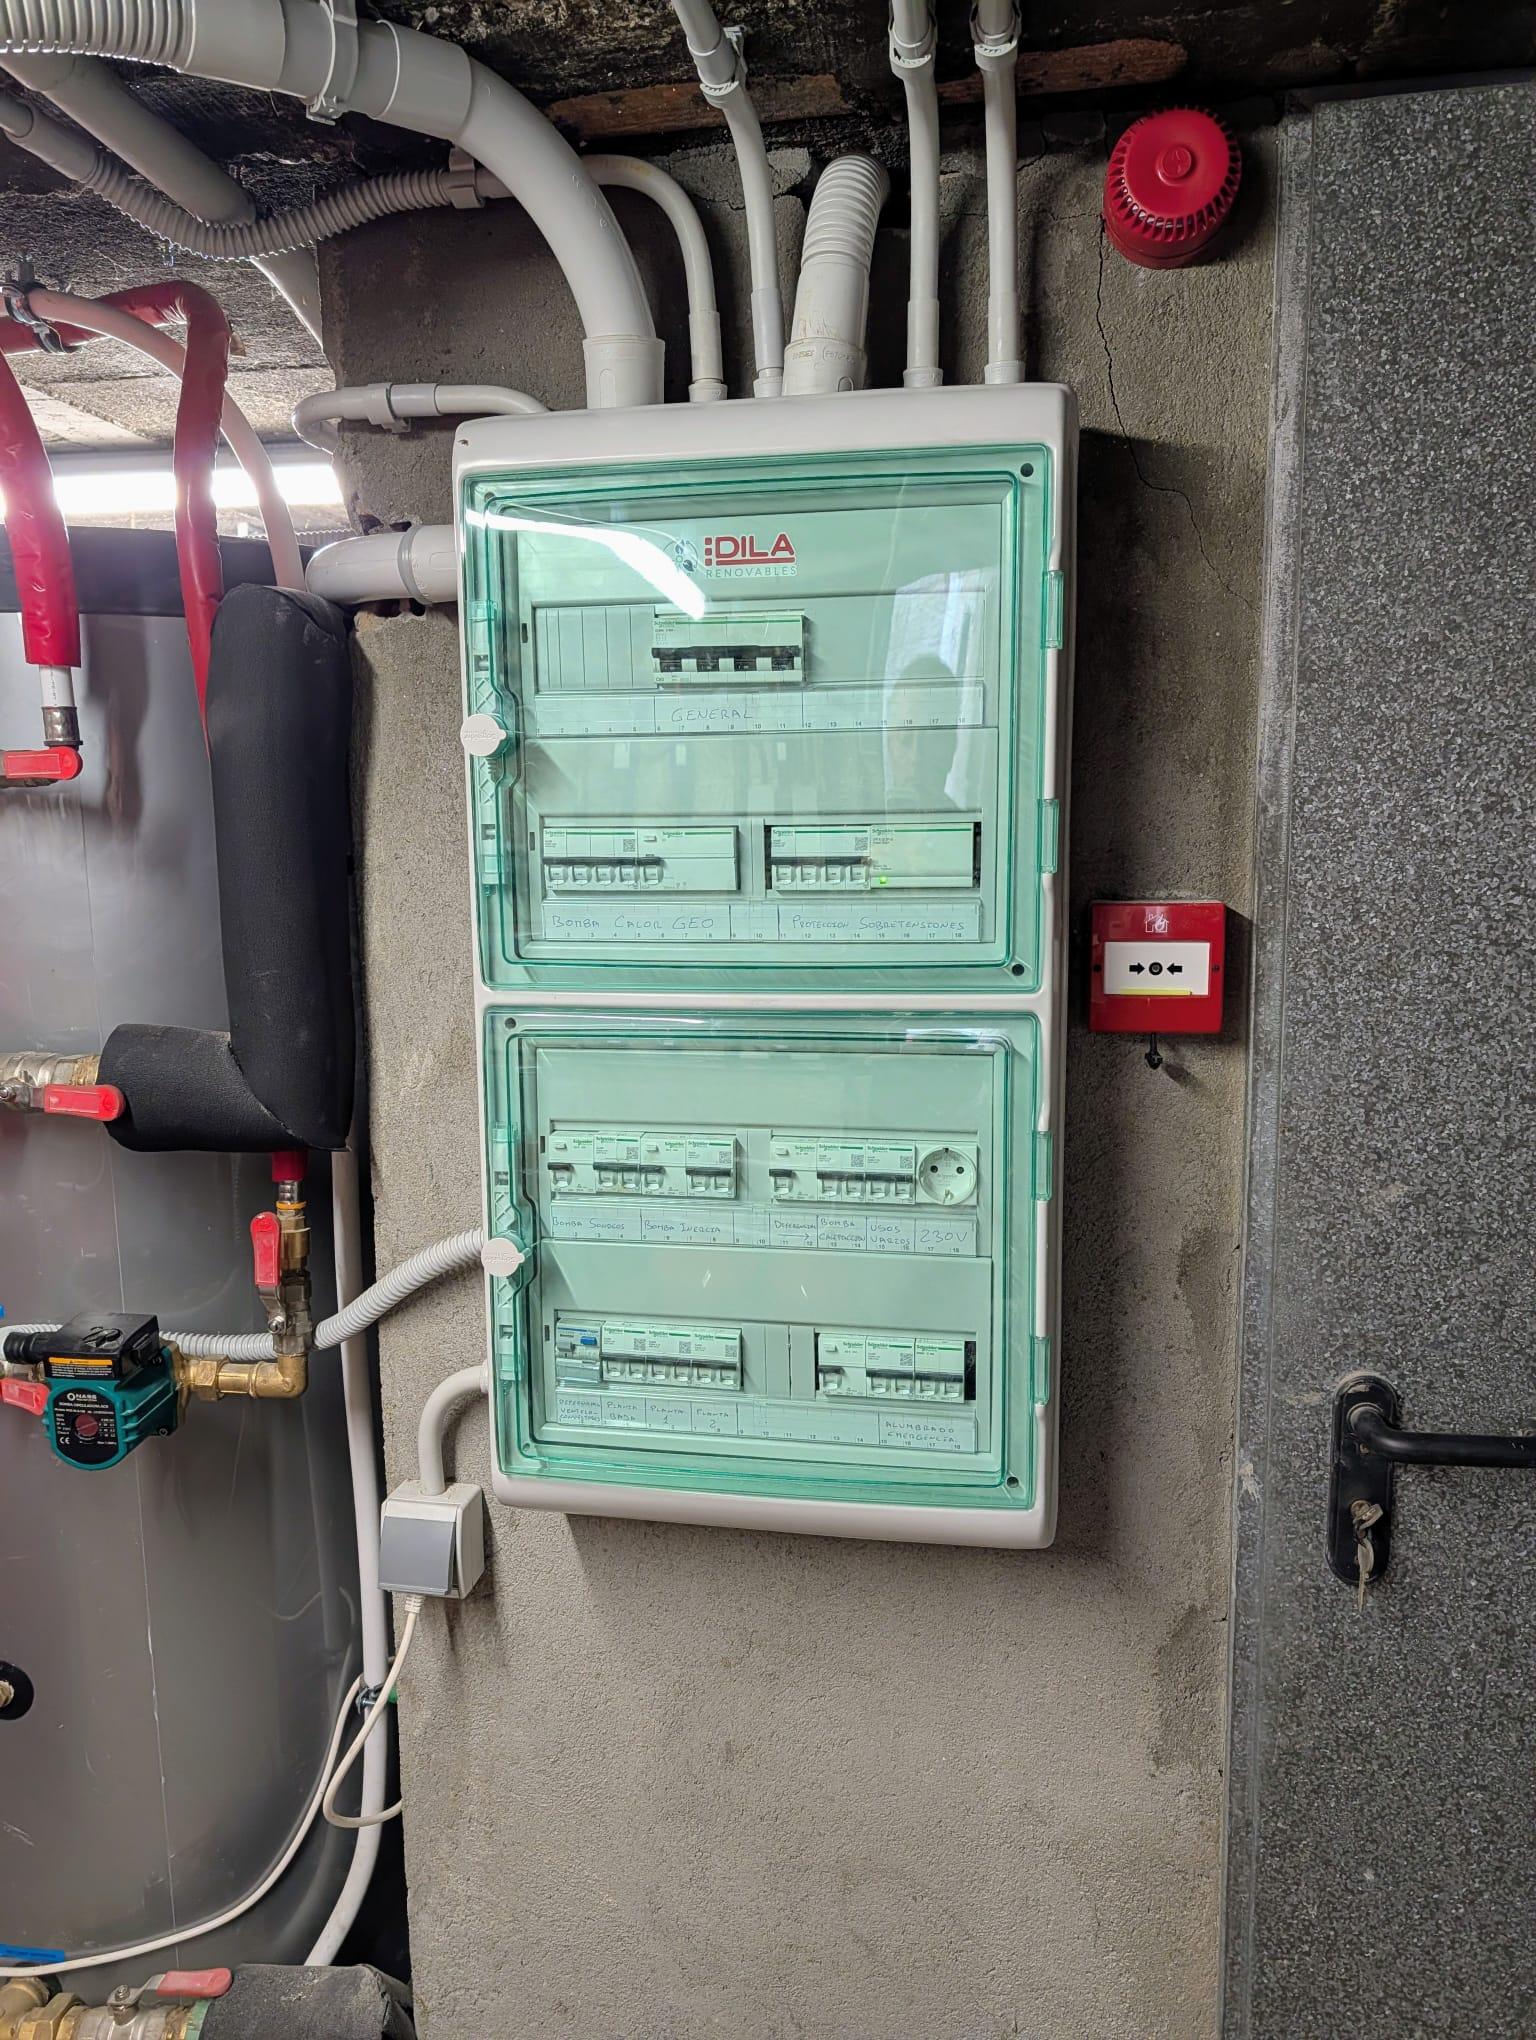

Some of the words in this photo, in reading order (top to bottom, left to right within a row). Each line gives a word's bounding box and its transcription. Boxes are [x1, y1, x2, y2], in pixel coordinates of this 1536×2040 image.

[706, 566, 796, 578] RENOVABLES
[672, 708, 753, 722] GENERAL
[672, 916, 714, 930] GEO
[870, 1224, 900, 1233] USOS
[920, 1229, 968, 1242] 230V
[709, 1420, 716, 1428] 2
[886, 1420, 954, 1433] ALUMBRADO
